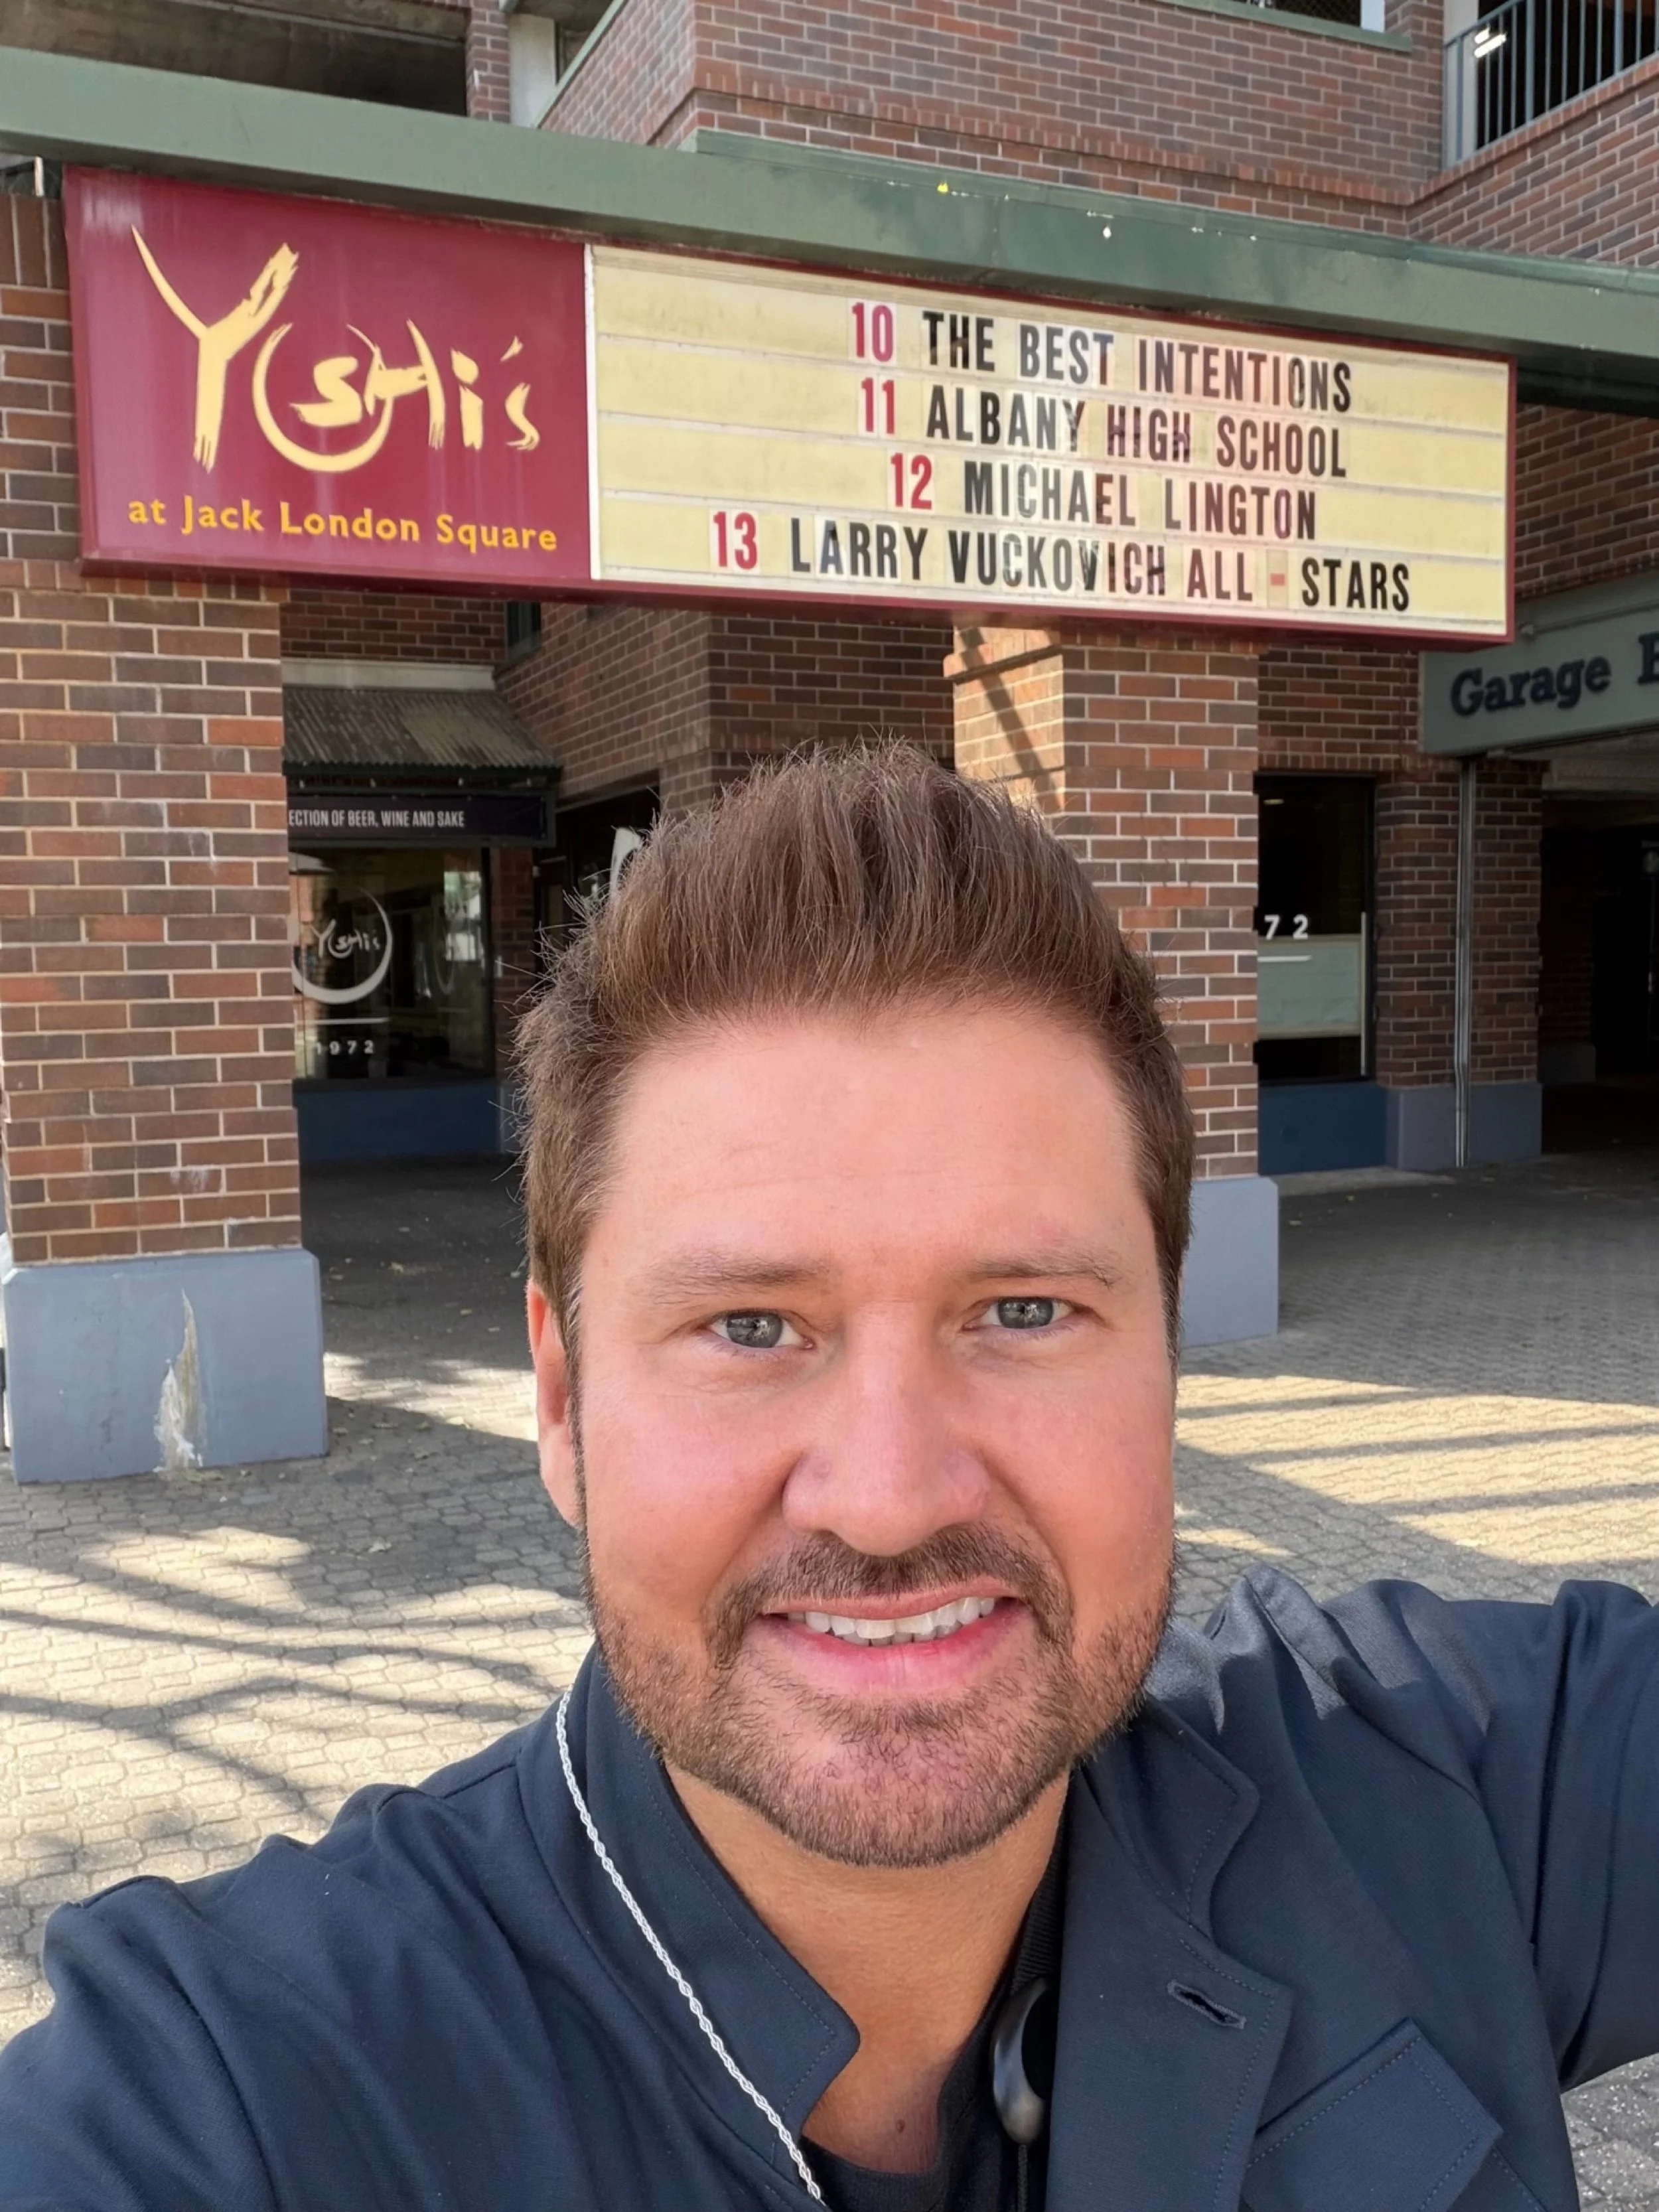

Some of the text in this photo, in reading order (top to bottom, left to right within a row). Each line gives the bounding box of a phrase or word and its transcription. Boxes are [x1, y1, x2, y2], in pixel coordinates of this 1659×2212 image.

[851, 302, 1352, 413] 10 THE BEST INTENTIONS
[861, 377, 1346, 478] 11 ALBANY HIGH SCHOOL
[128, 494, 557, 555] at Jack London Square
[891, 453, 1315, 540] 12 MICHAEL LINGTON
[713, 510, 758, 570] 13
[790, 517, 928, 581] LARRY
[948, 530, 1166, 596] VUCKOVICH
[1451, 656, 1612, 717] Garage
[331, 809, 345, 827] OF
[380, 810, 410, 828] WINE
[412, 810, 435, 828] AND
[437, 810, 465, 828] SAKE
[316, 1040, 375, 1056] 1972
